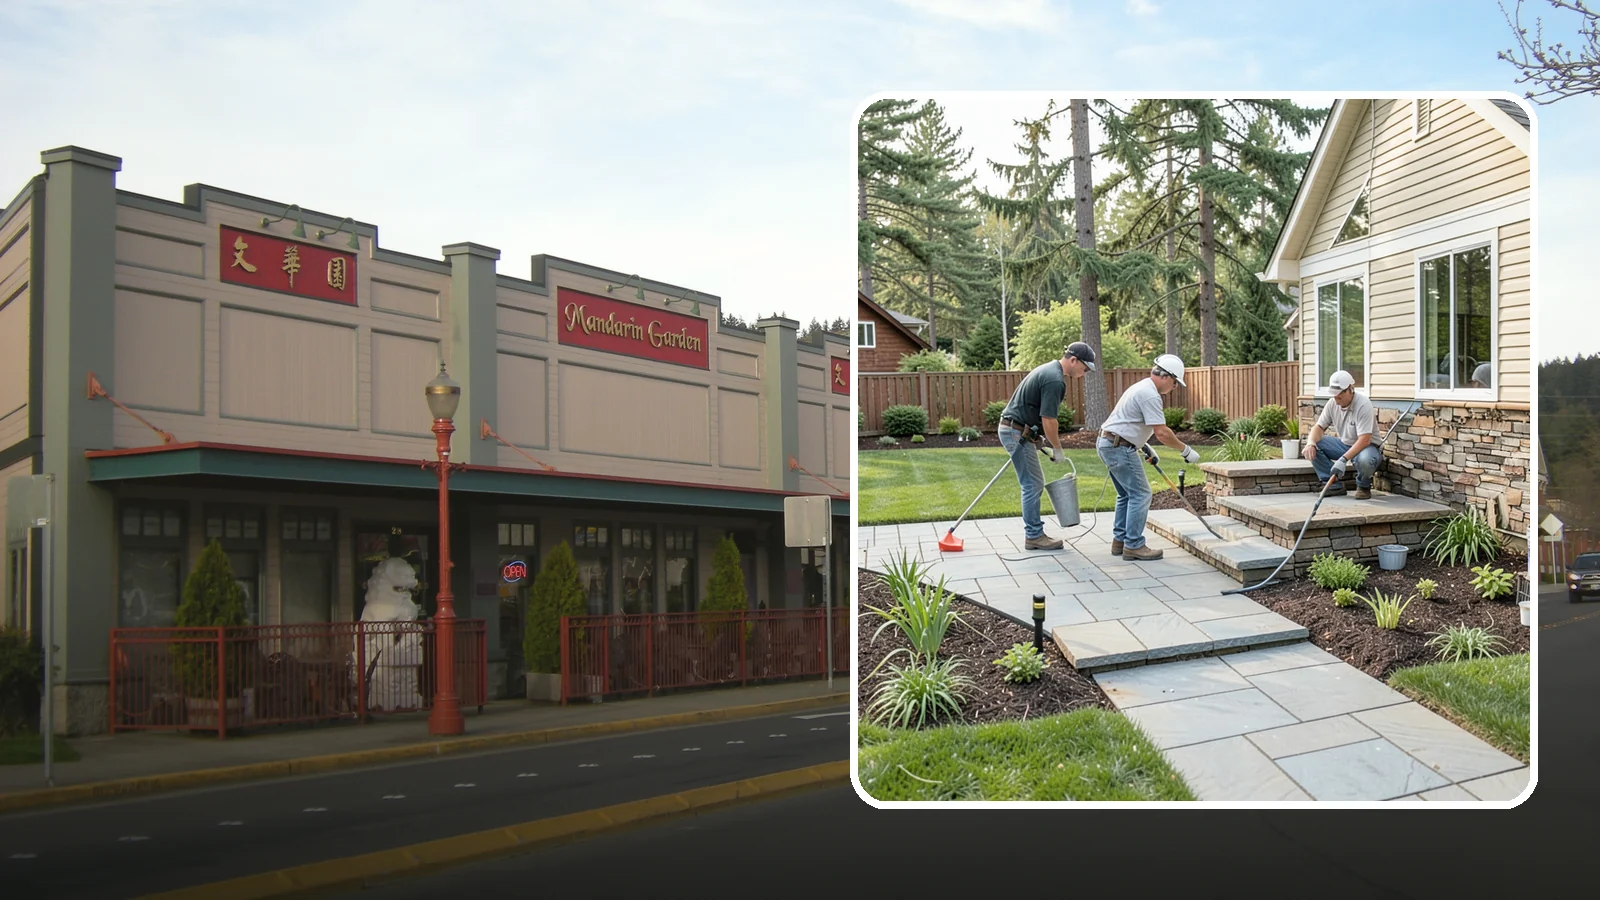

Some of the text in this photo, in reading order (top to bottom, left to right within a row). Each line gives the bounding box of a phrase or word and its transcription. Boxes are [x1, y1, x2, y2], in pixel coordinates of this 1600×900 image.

[564, 302, 701, 352] Mandarin Garden
[503, 565, 527, 578] OPEN
